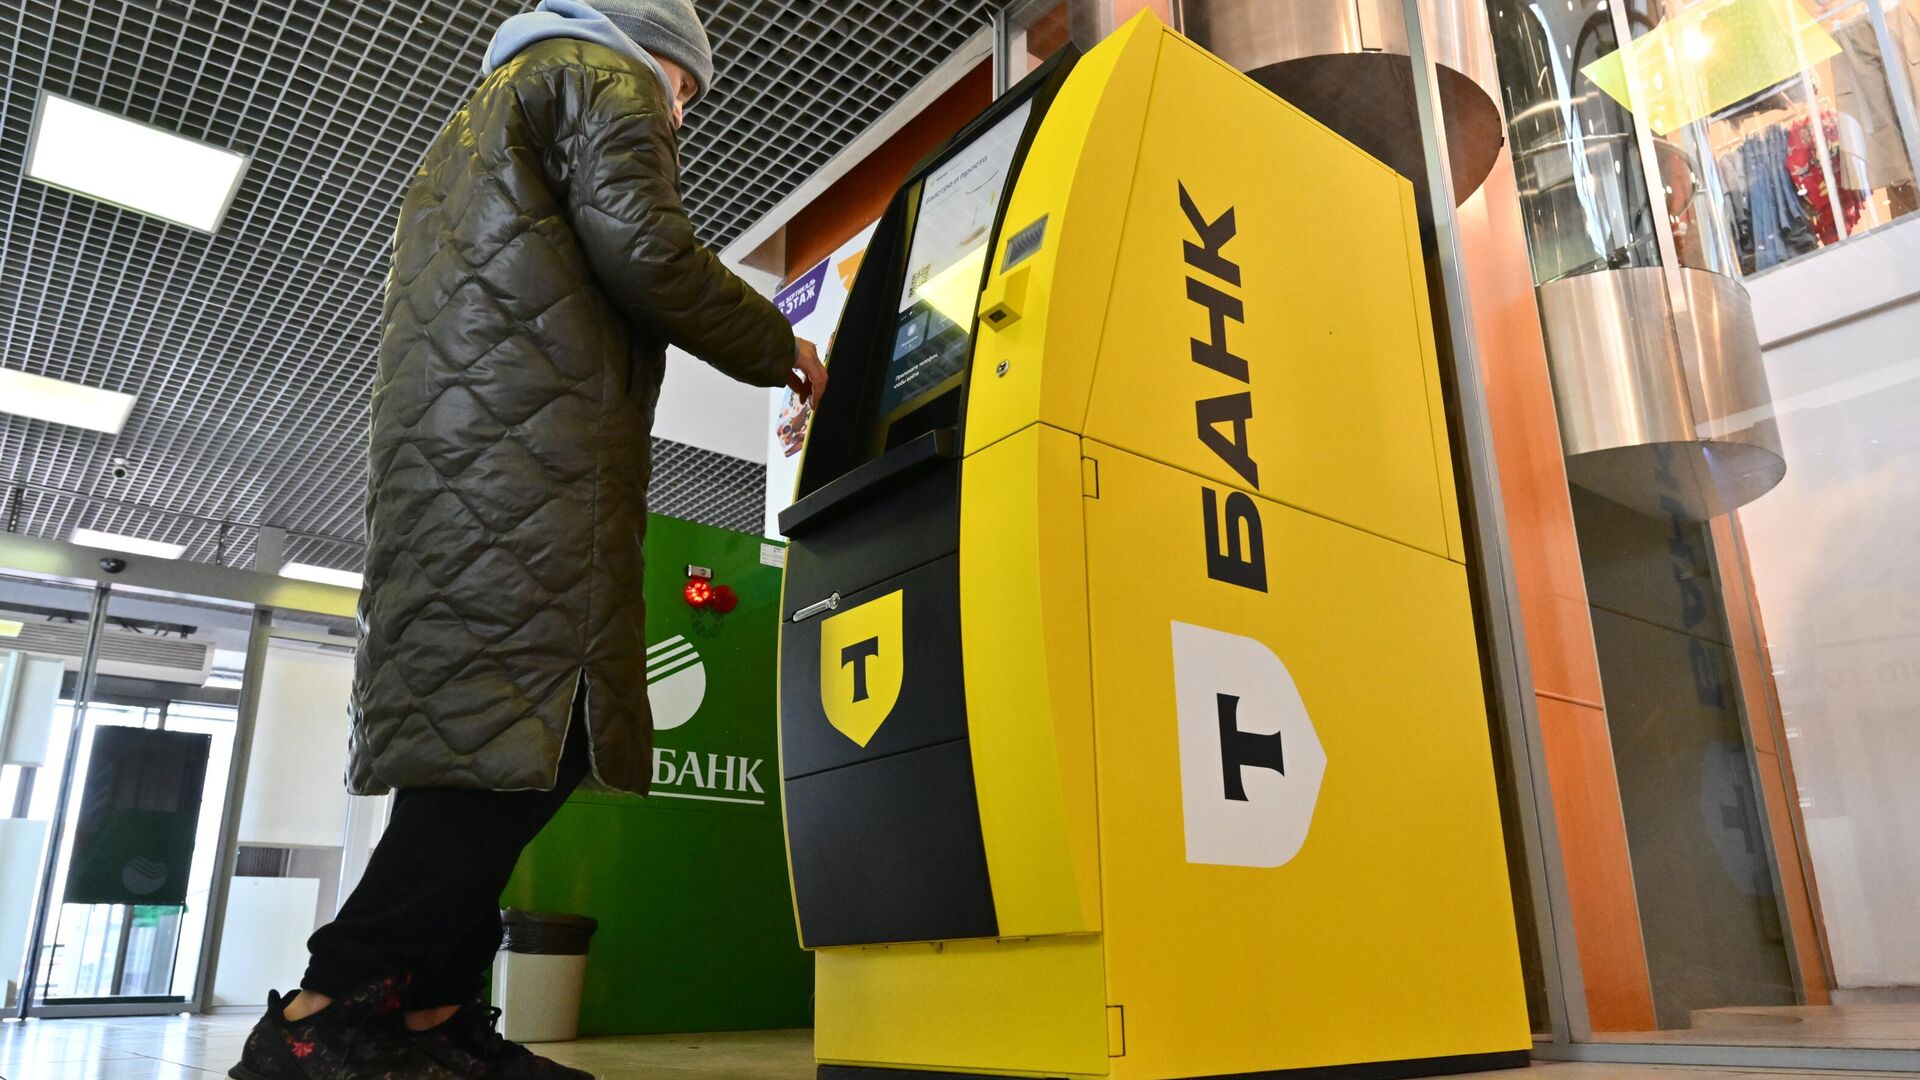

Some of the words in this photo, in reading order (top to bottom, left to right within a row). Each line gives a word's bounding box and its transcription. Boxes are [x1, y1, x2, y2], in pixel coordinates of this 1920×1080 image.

[786, 285, 815, 315] ЭТАЖ
[1178, 178, 1268, 593] БАНК
[651, 747, 766, 794] БАНК
